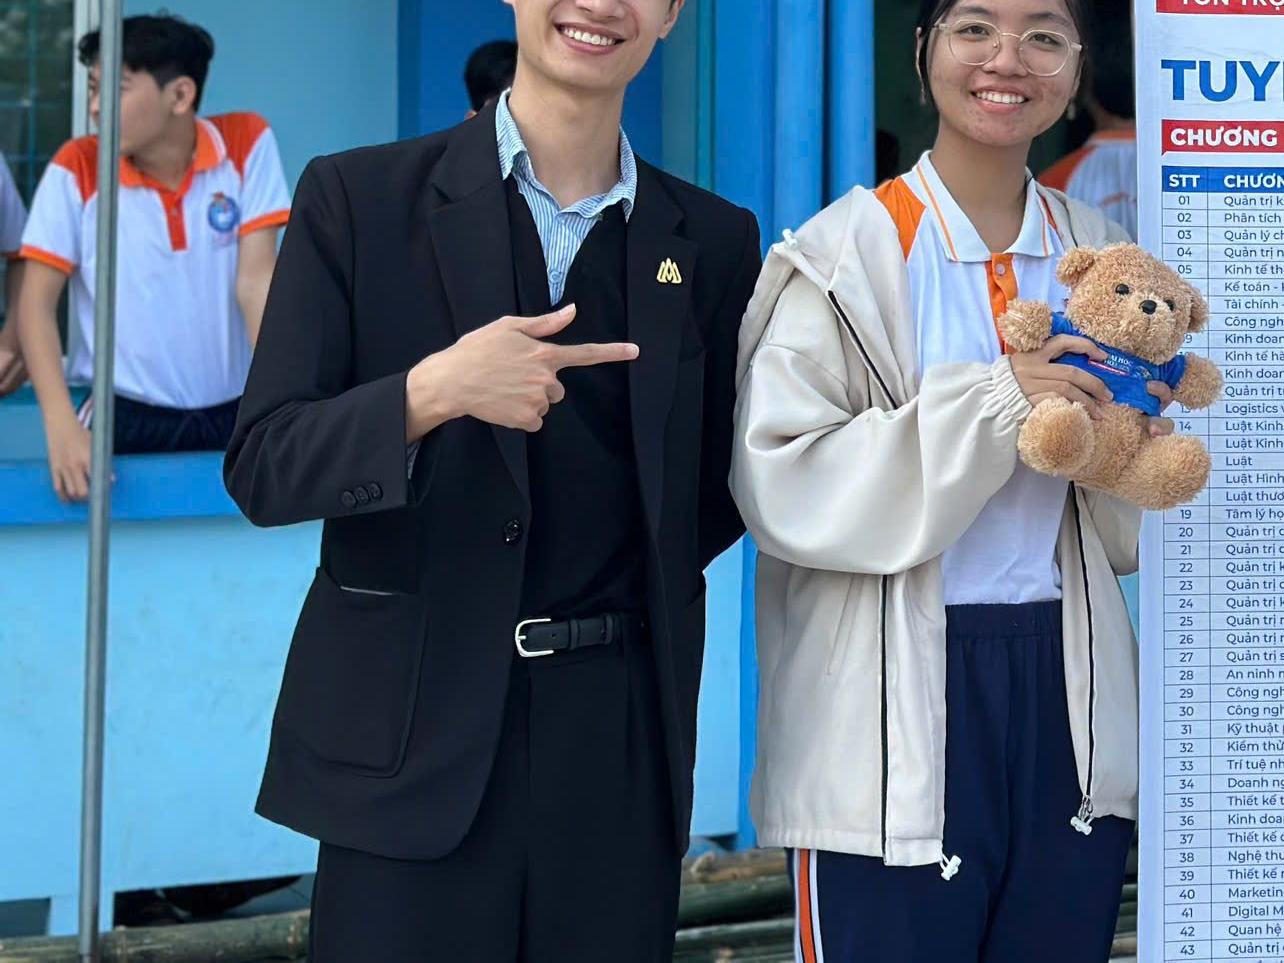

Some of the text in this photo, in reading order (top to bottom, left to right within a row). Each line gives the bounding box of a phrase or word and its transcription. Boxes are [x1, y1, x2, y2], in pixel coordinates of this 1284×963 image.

[1170, 125, 1277, 146] CHƯƠNG
[1169, 174, 1200, 187] STT
[1178, 195, 1189, 205] 01
[1223, 194, 1256, 207] Quản
[1259, 195, 1272, 207] trị
[1177, 212, 1191, 222] 02
[1224, 212, 1255, 222] Phân
[1258, 212, 1281, 223] tích
[1224, 316, 1256, 328] Công
[1225, 402, 1278, 415] Logistics
[1178, 421, 1192, 431] 14
[1225, 420, 1252, 433] Luật
[1255, 420, 1283, 431] Kinh
[1180, 509, 1191, 519] 19
[1225, 508, 1252, 519] Tâm
[1255, 508, 1265, 521] lý
[1179, 562, 1192, 572] 22
[1225, 560, 1259, 573] Quản
[1262, 560, 1275, 574] trị
[1179, 669, 1193, 680] 28
[1226, 669, 1243, 679] An
[1247, 668, 1274, 678] ninh
[1179, 688, 1193, 698] 29
[1226, 686, 1259, 699] Công
[1179, 778, 1194, 789] 34
[1227, 777, 1268, 788] Doanh
[1179, 852, 1194, 863] 38
[1228, 849, 1261, 863] Nghệ
[1179, 889, 1195, 899] 40
[1181, 907, 1192, 918] 41
[1228, 905, 1269, 919] Digital
[1180, 944, 1194, 955] 43
[1228, 941, 1262, 955] Quản
[1265, 941, 1279, 955] trị
